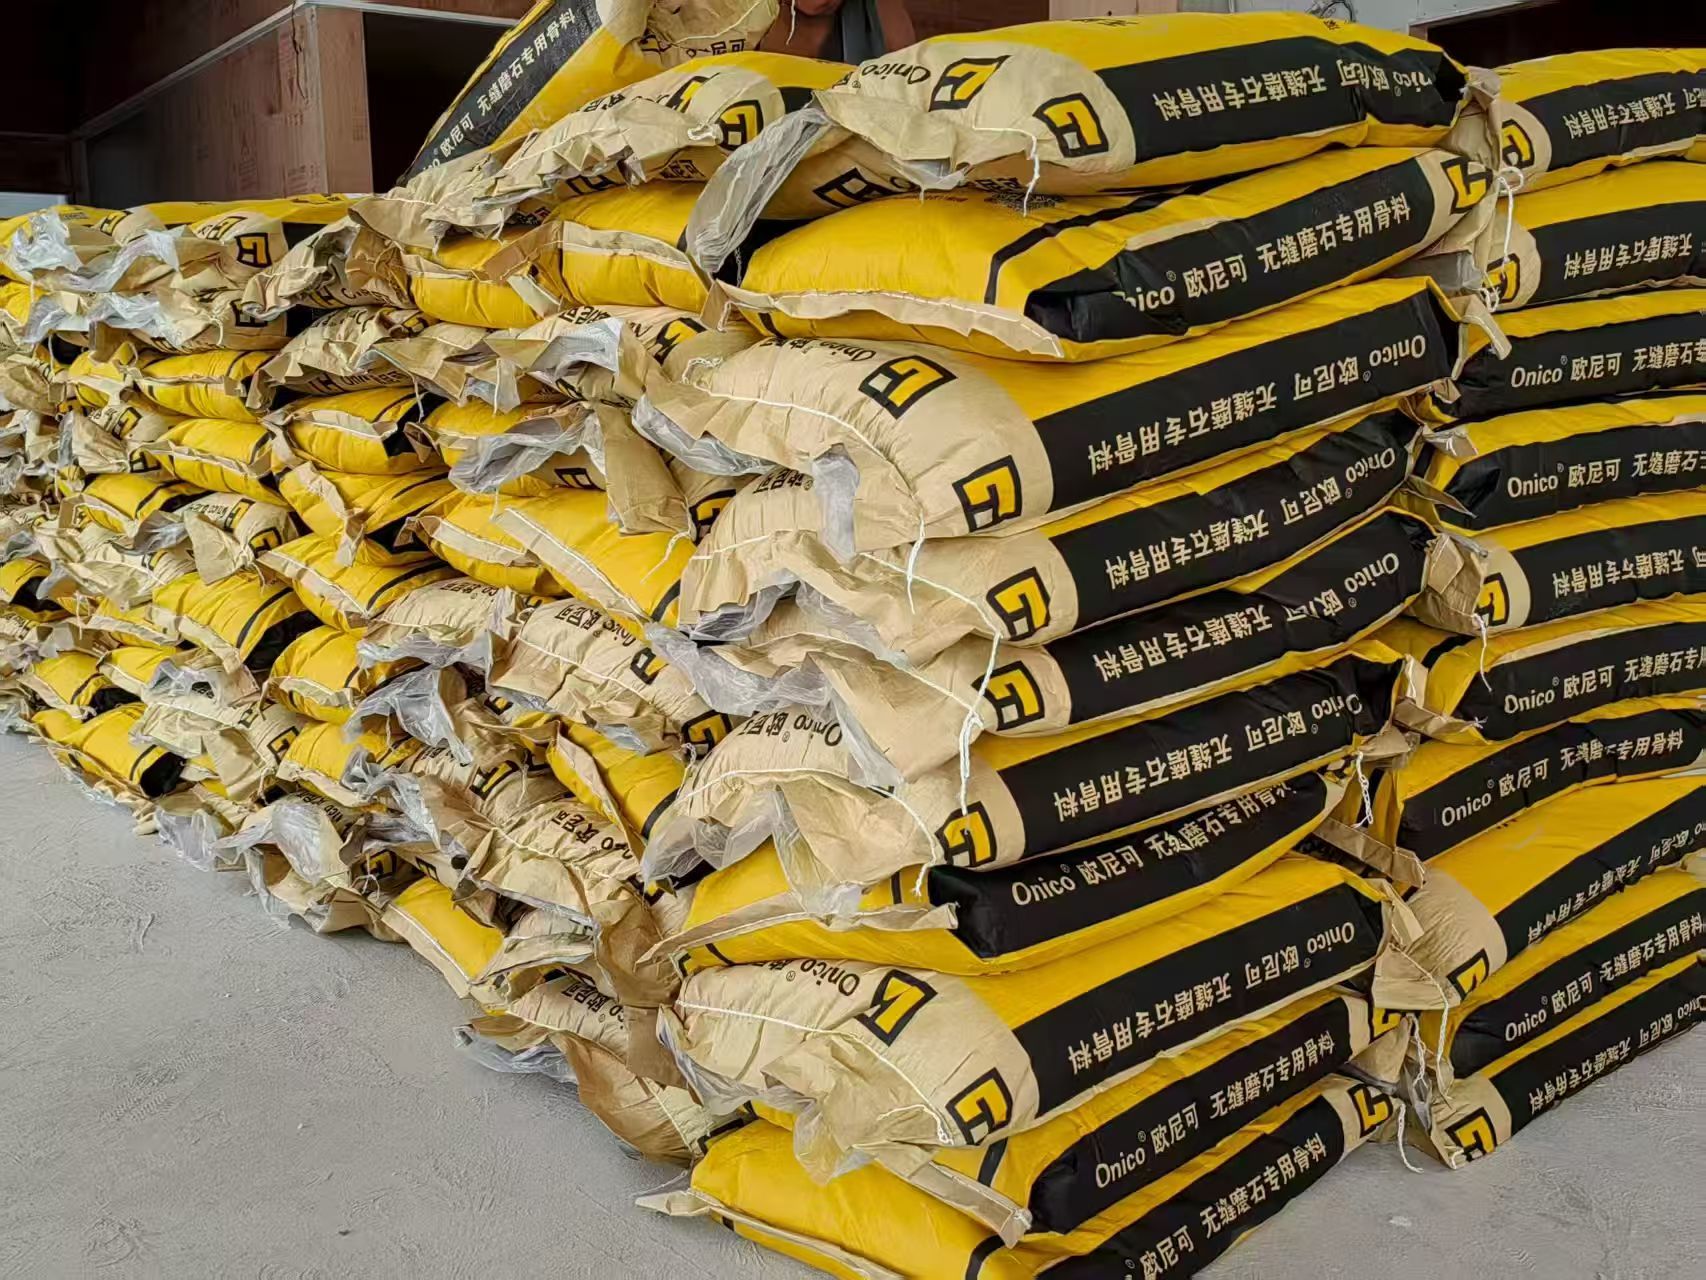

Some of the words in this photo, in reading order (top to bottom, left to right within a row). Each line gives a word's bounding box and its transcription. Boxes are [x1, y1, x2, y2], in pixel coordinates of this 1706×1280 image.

[439, 114, 476, 159] 欧尼可
[475, 9, 576, 118] 无缝磨石专用骨料
[1152, 64, 1326, 122] 无缝磨石专用骨料
[1563, 90, 1677, 139] 无缝磨石专用骨料
[1182, 253, 1248, 300] 欧尼可
[1255, 191, 1412, 275] 无缝磨石专用骨料
[1563, 231, 1693, 281] 无缝磨石专用骨料
[1293, 355, 1360, 402] 欧尼可
[1569, 352, 1623, 382] 欧尼可
[1087, 381, 1278, 477] 无缝磨石专用骨料
[1567, 458, 1622, 488] 欧尼可
[1279, 475, 1343, 526] 欧尼可
[1104, 508, 1270, 591] 无缝磨石专用骨料
[1552, 548, 1685, 599] 无缝磨石专用骨料
[1091, 603, 1273, 683] 无缝磨石专用骨料
[1562, 665, 1616, 699] 欧尼可
[1244, 710, 1308, 753] 欧尼可
[1053, 732, 1234, 821] 无缝磨石专用骨料
[1497, 757, 1550, 799] 欧尼可
[1075, 844, 1145, 886] 欧尼可
[1244, 944, 1300, 991] 欧尼可
[1550, 971, 1594, 1015] 欧尼可
[1598, 912, 1705, 983] 无缝磨石专用骨料
[1066, 971, 1233, 1076] 无缝磨石专用骨料
[1637, 1012, 1674, 1049] 欧尼可
[1150, 1102, 1200, 1155] 欧尼可
[1209, 1030, 1336, 1121] 无缝磨石专用骨料
[1528, 1036, 1632, 1116] 无缝磨石专用骨料
[1138, 1224, 1196, 1280] 欧尼可
[1199, 1131, 1328, 1240] 无缝磨石专用骨料
